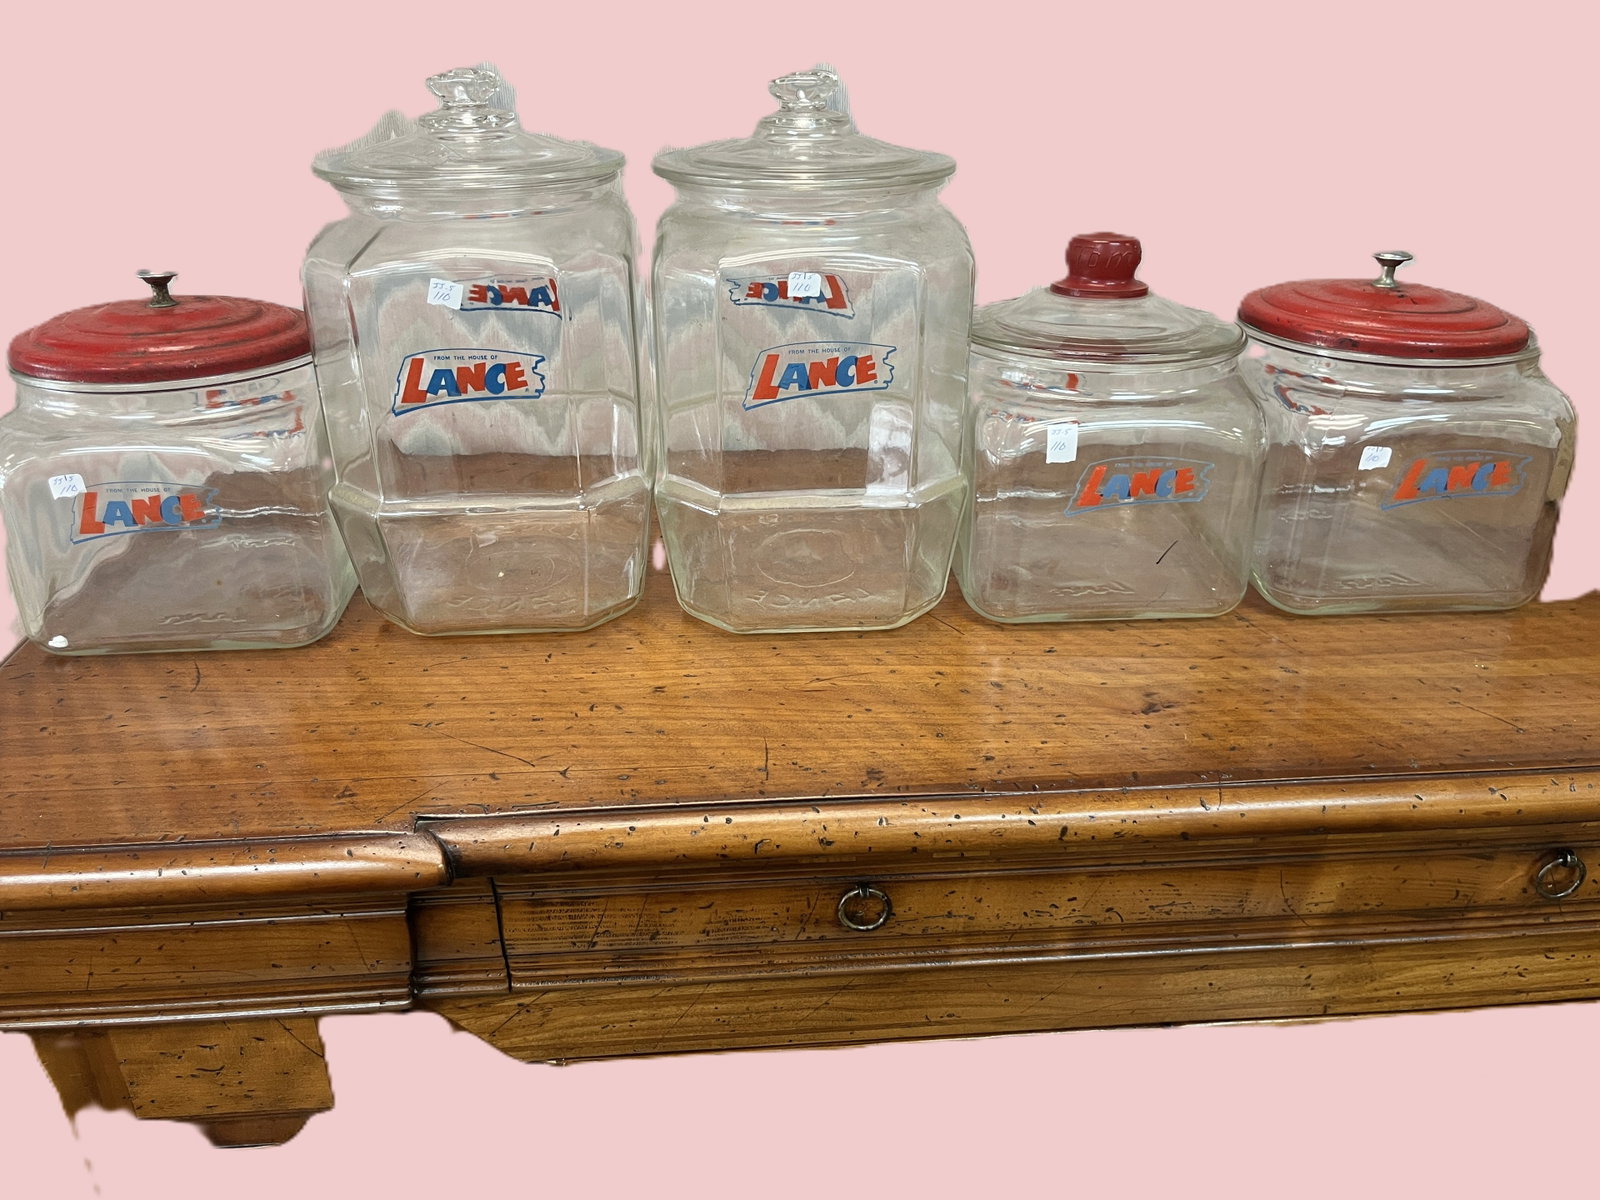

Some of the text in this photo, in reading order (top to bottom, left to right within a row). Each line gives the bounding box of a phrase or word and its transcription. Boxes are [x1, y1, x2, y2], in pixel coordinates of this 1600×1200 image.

[401, 357, 528, 404] LANCE
[752, 354, 878, 400] LANCE
[1077, 465, 1196, 507] LANCE
[1393, 458, 1512, 500] LANCE
[79, 491, 206, 535] LANCE
